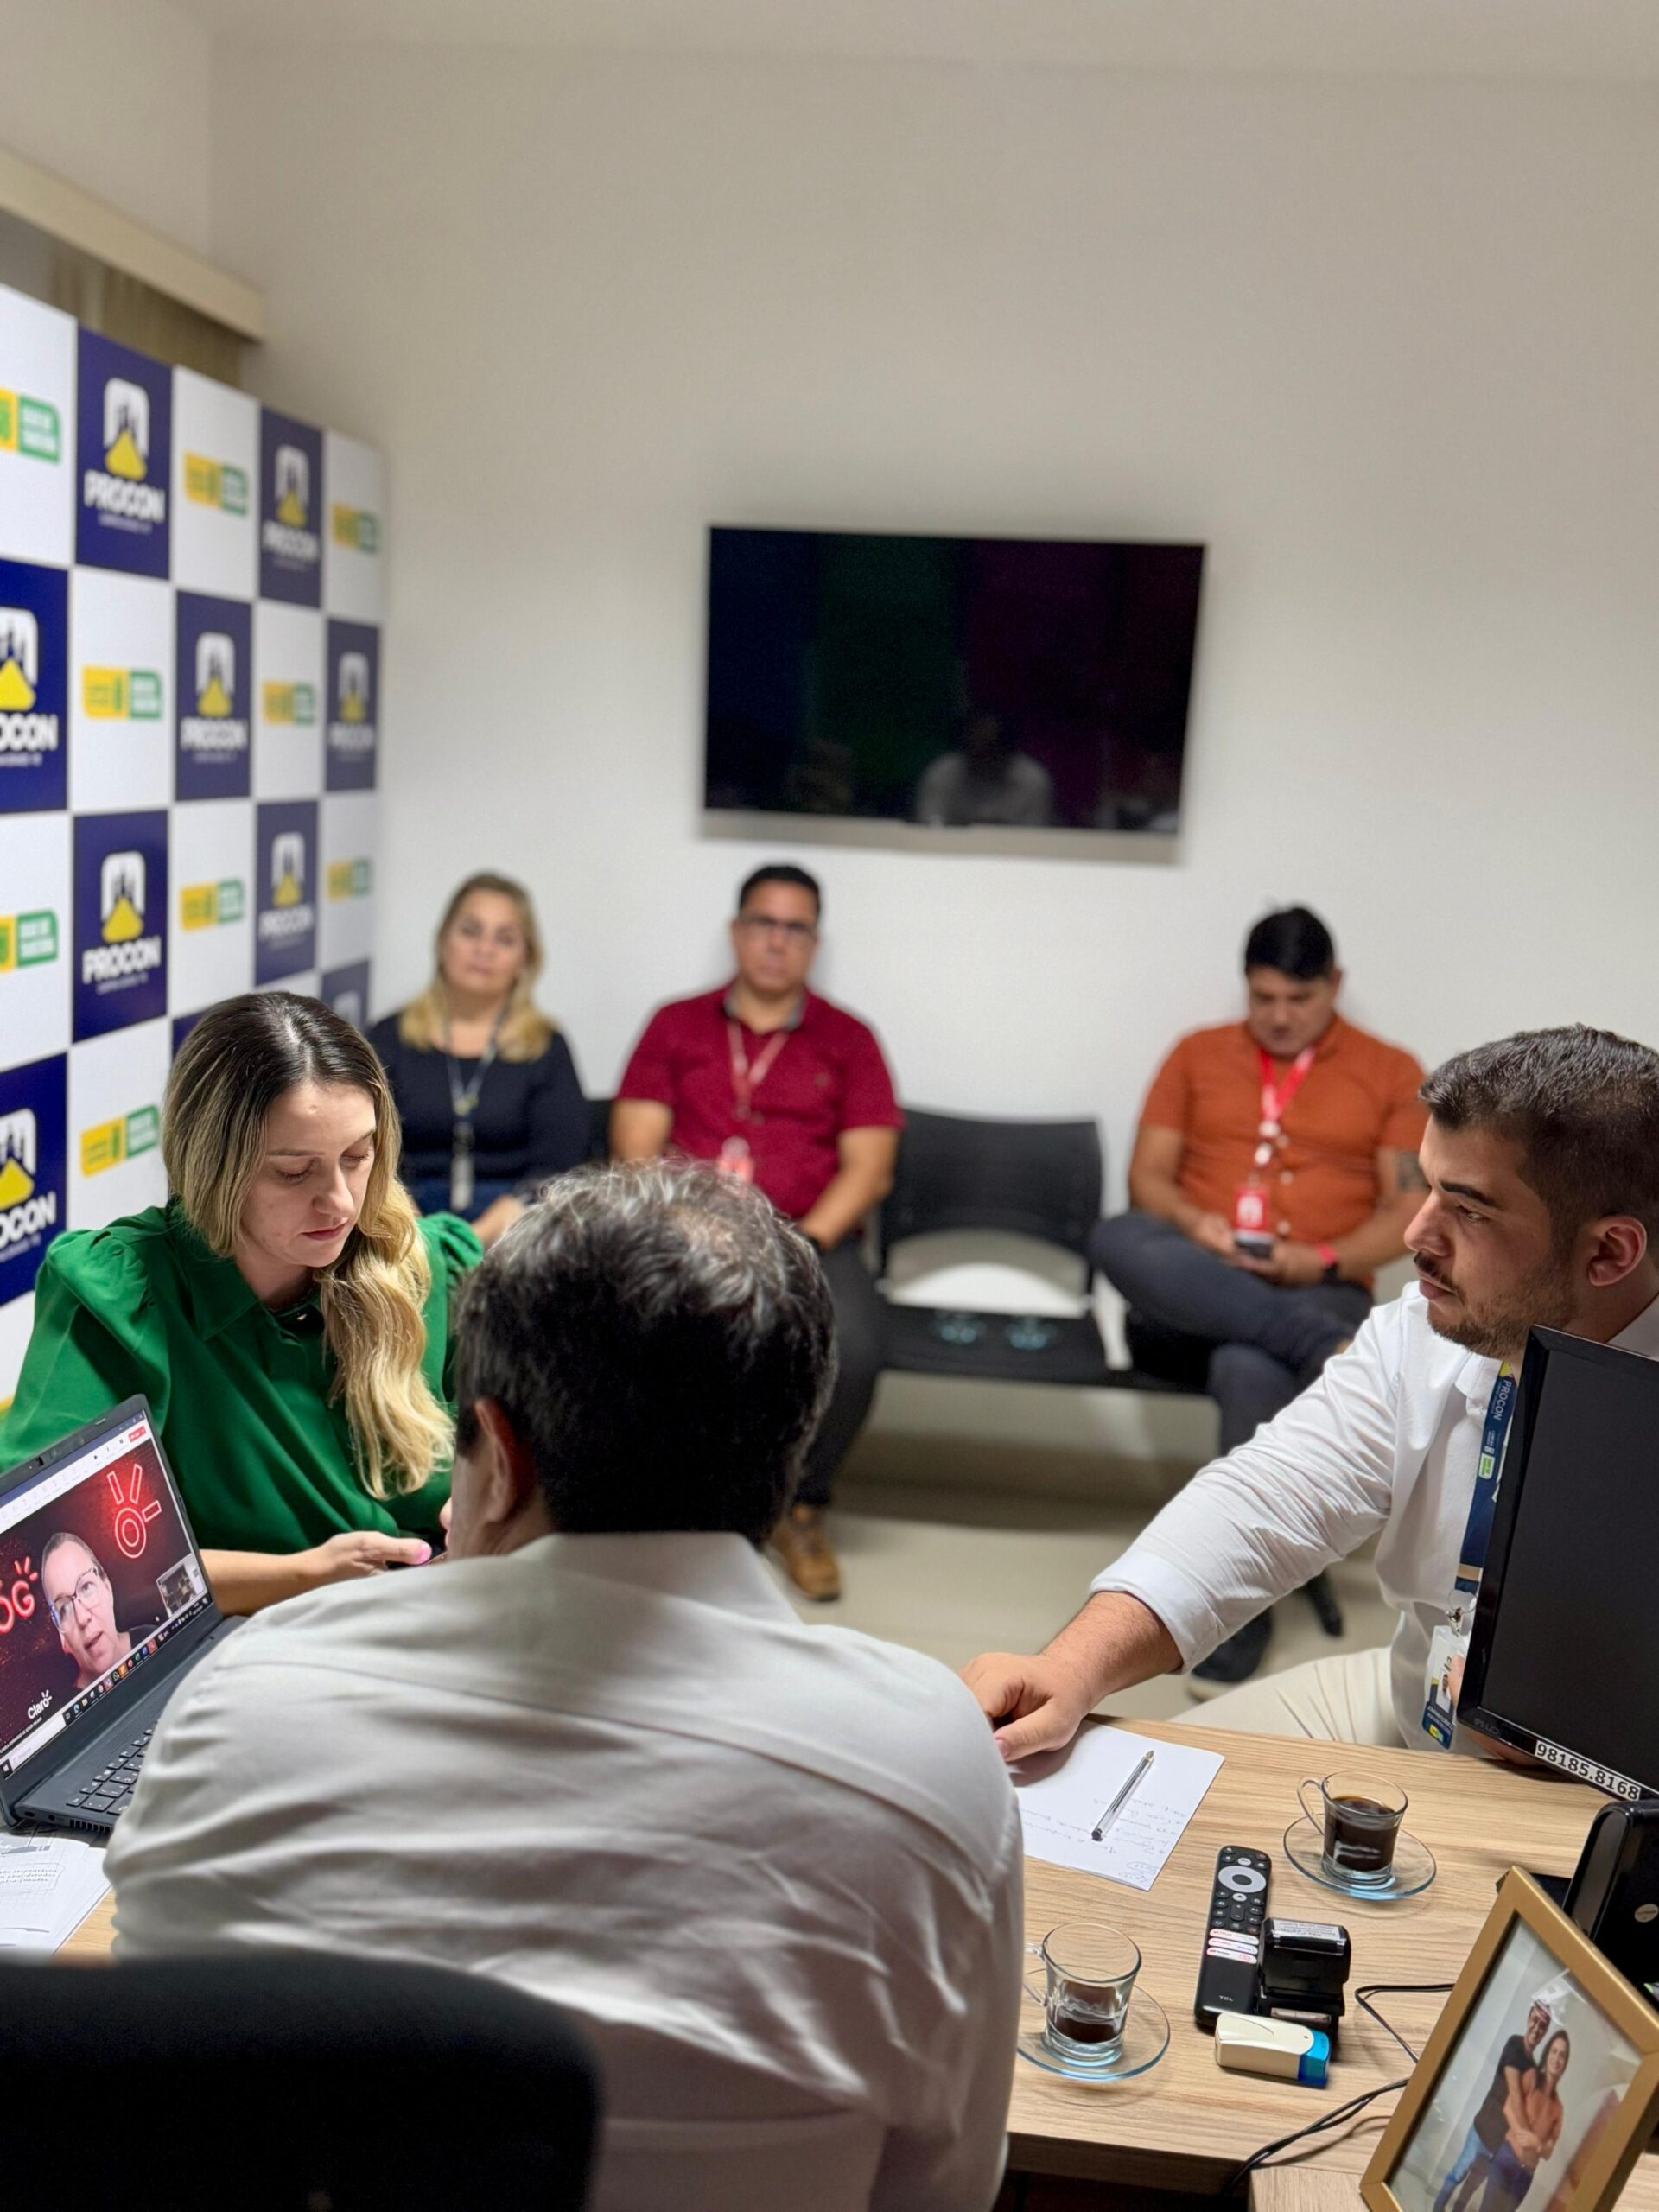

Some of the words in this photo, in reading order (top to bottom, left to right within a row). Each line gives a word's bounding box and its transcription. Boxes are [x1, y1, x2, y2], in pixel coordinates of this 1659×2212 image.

[82, 936, 162, 984] PROCON
[1493, 1379, 1512, 1421] PROCON
[1536, 1744, 1640, 1800] 98185.8168
